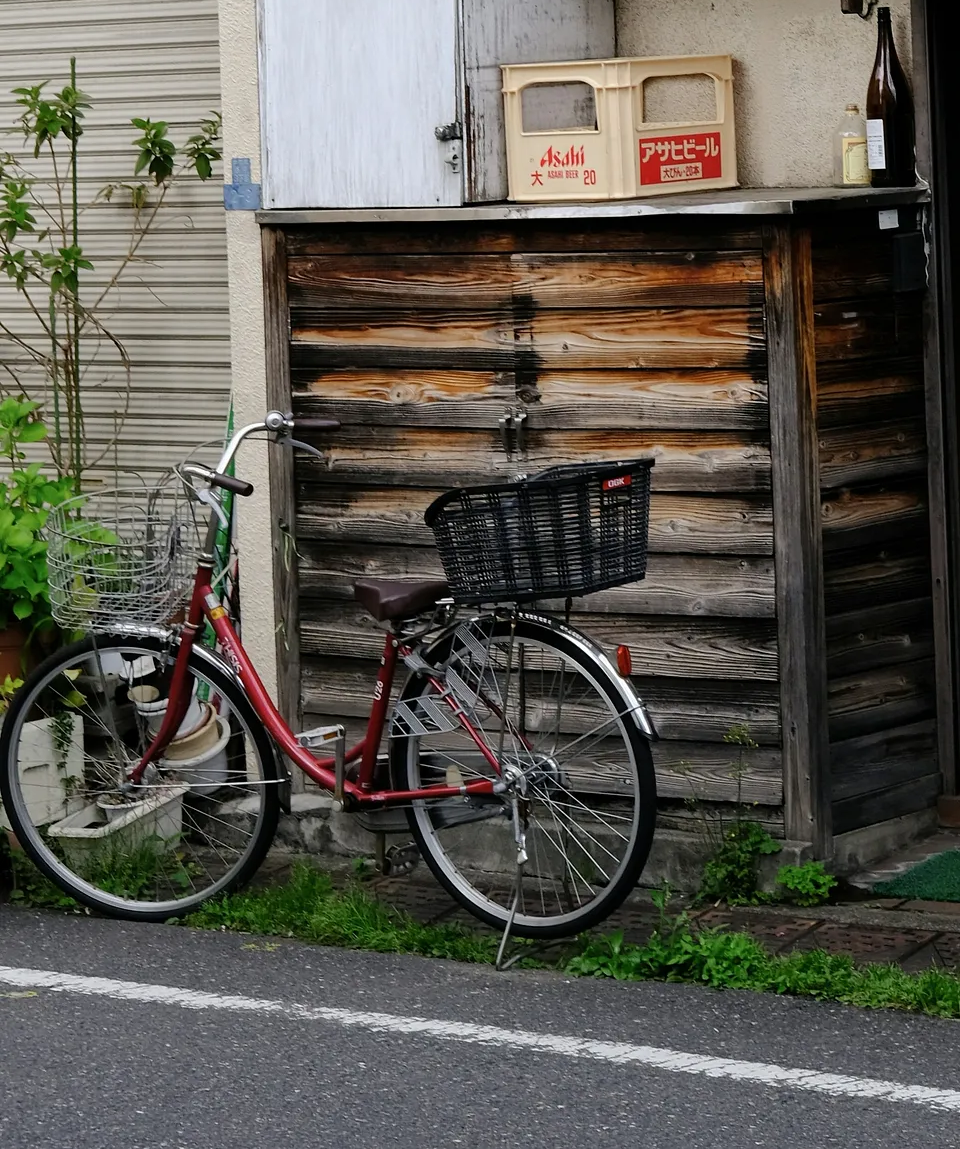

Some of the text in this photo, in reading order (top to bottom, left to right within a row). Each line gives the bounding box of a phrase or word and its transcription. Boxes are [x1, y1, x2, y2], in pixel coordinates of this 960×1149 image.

[540, 145, 585, 167] Asahi
[641, 137, 719, 163] アサヒビール
[531, 170, 543, 186] 大
[583, 170, 597, 186] 20
